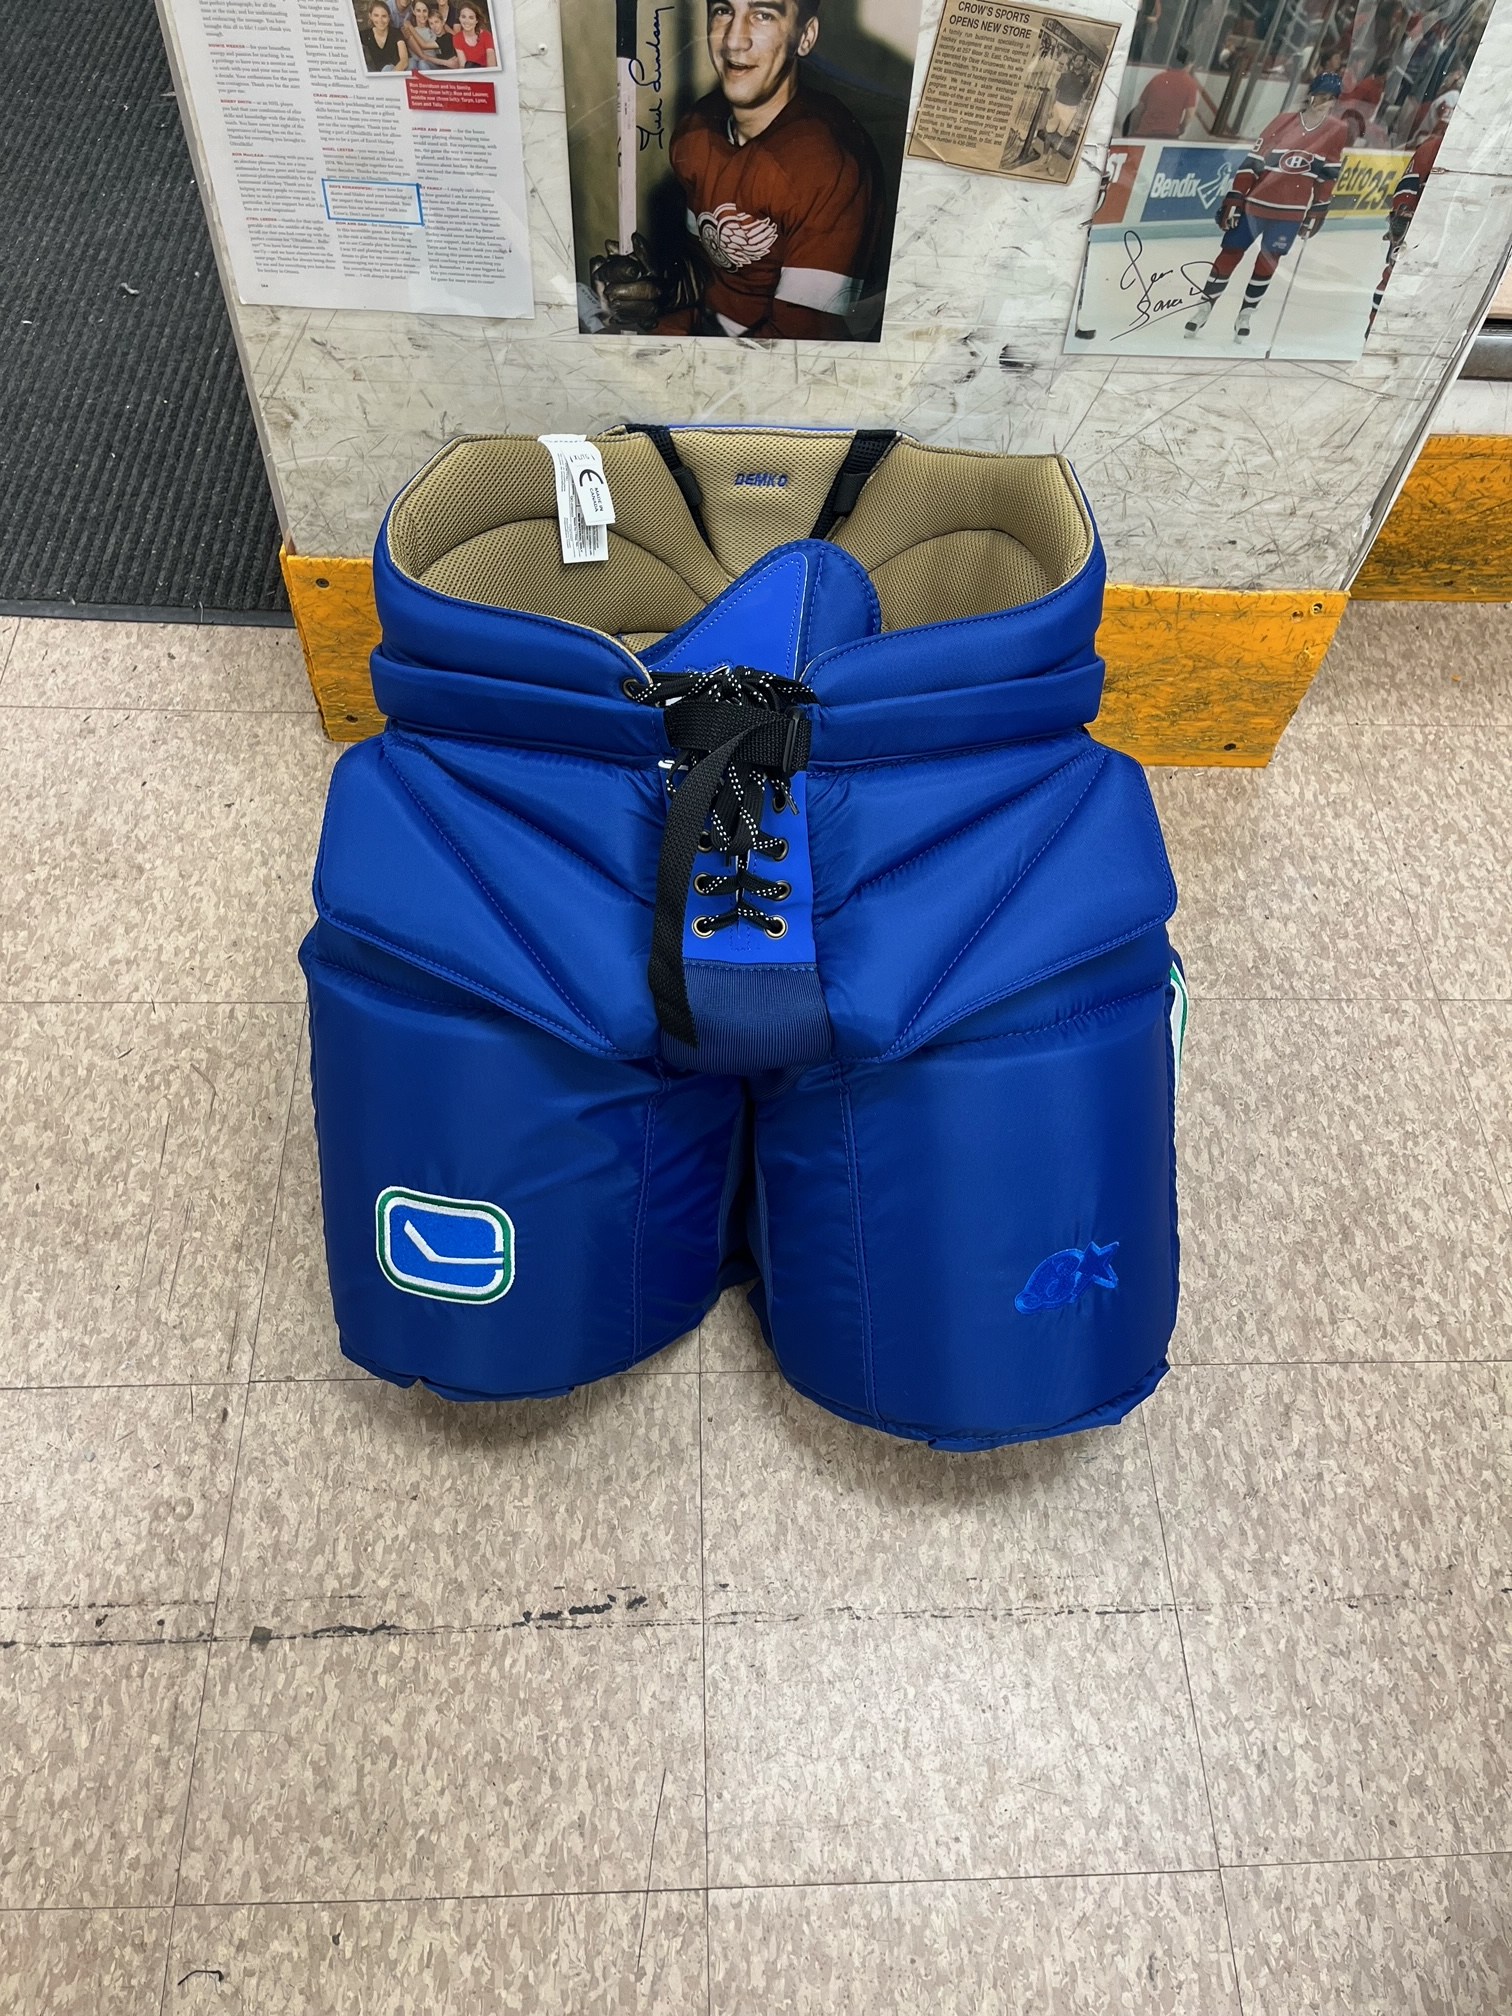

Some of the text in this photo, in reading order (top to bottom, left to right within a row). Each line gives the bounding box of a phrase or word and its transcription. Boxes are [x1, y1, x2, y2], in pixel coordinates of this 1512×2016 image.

[958, 1, 1030, 24] CROW'S SPORTS
[949, 15, 1032, 39] OPENS NEW STORE
[941, 35, 957, 44] hockey
[959, 39, 982, 48] equipment
[1012, 49, 1029, 57] opened
[949, 28, 962, 37] family
[975, 33, 995, 43] business
[998, 39, 1024, 49] specializing
[939, 44, 956, 52] recently
[942, 52, 961, 60] operated
[944, 68, 967, 77] assortment
[972, 74, 987, 82] hockey
[988, 77, 1013, 86] memorabilia
[996, 87, 1017, 95] exchange
[925, 96, 947, 105] equipment
[988, 100, 1013, 111] sharpening
[960, 117, 984, 127] Competitive
[984, 122, 998, 131] pricing
[964, 126, 977, 134] strong
[1336, 156, 1373, 192] etro
[1150, 173, 1200, 198] Bendix
[735, 472, 788, 487] DEMKO
[590, 488, 598, 512] CANADA
